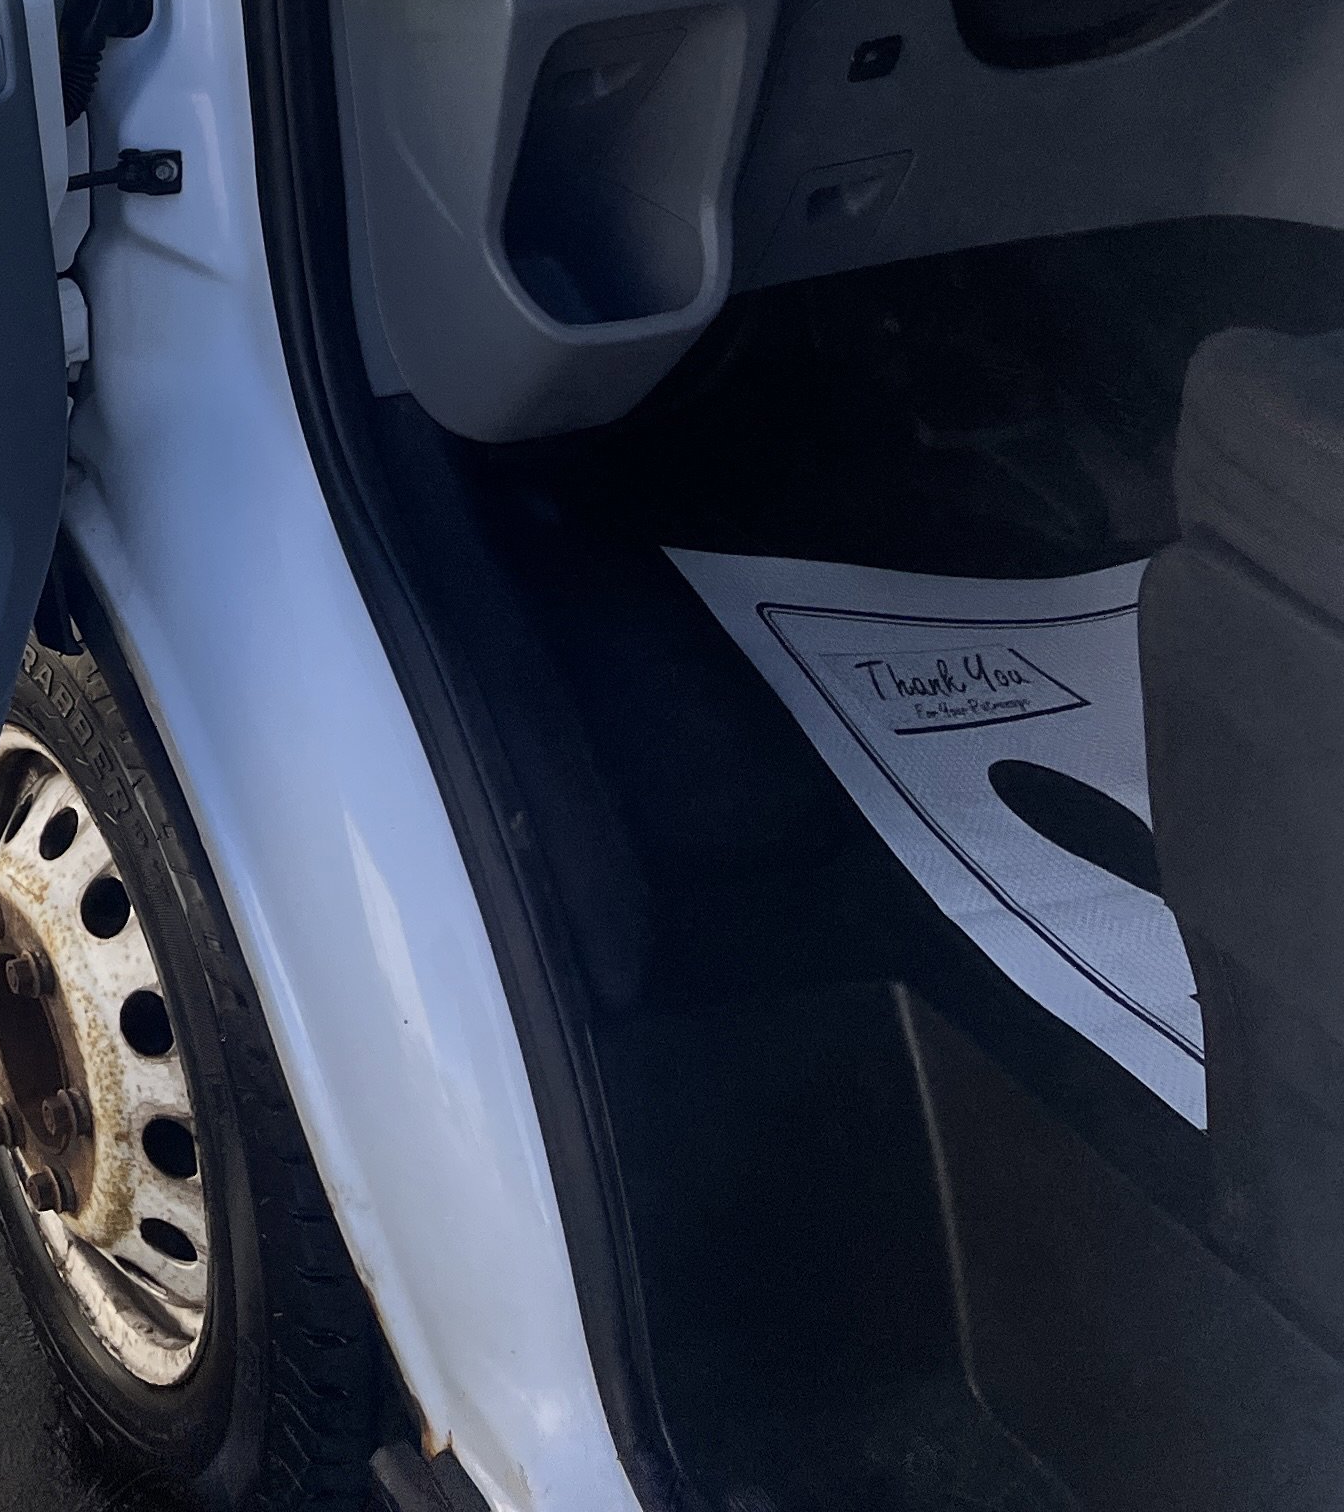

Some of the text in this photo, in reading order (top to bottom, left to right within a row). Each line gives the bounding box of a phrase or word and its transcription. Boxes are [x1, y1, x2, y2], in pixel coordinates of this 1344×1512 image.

[22, 642, 132, 817] RABBER
[854, 653, 1032, 701] Thank You
